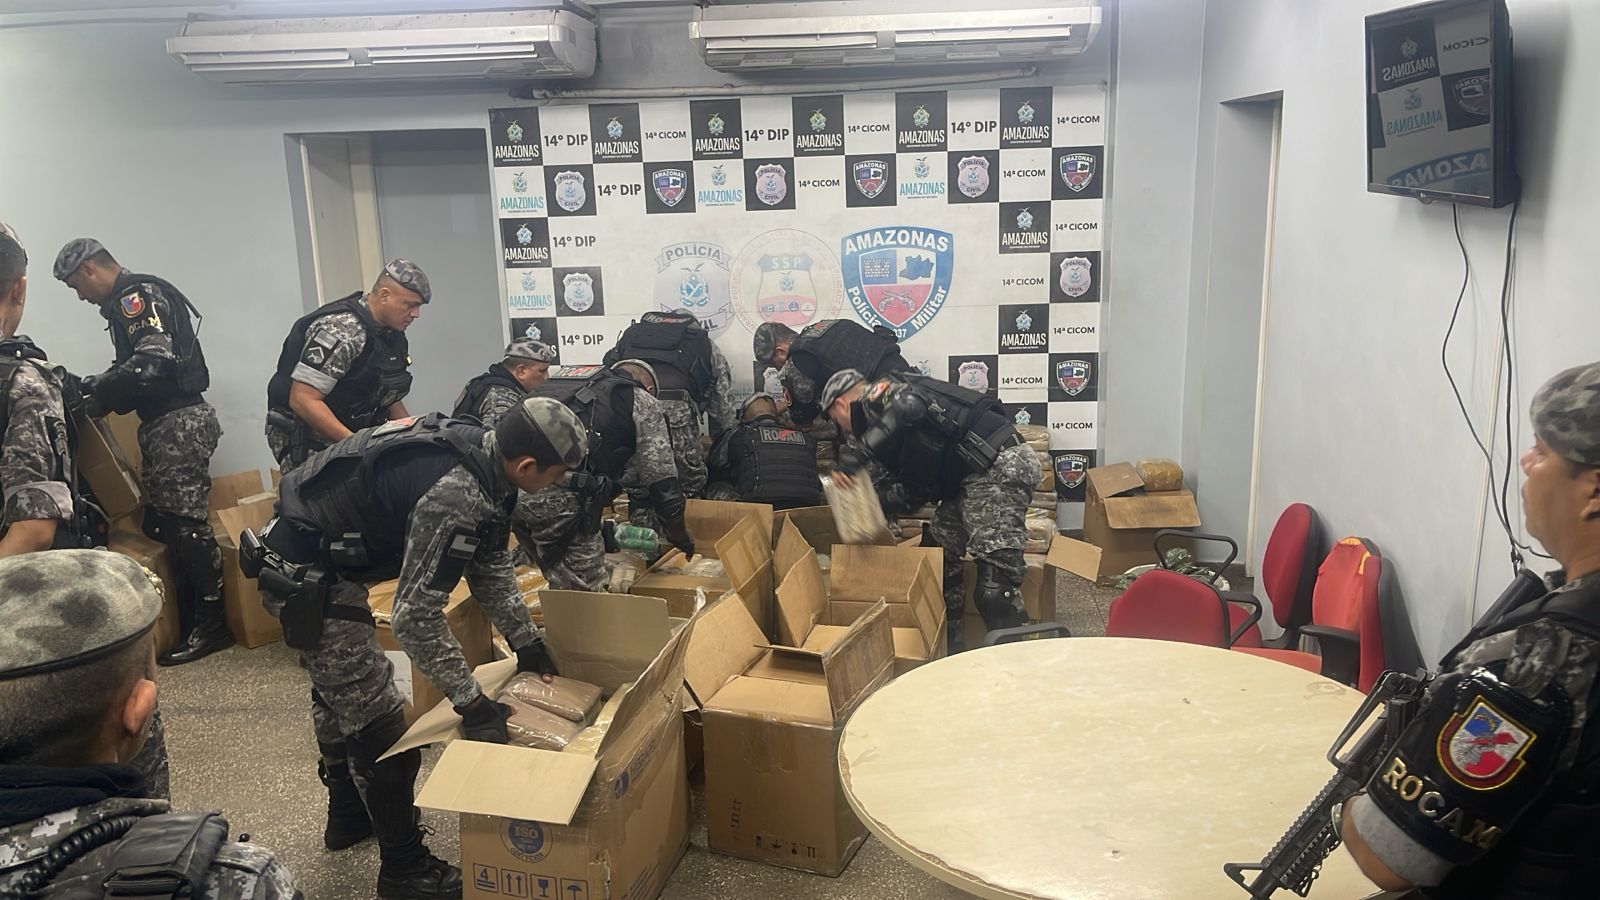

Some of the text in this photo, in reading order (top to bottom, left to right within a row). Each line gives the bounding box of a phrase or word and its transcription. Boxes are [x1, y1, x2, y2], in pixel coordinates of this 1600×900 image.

[1071, 115, 1100, 124] CICOM
[862, 124, 890, 133] CICOM
[974, 120, 997, 133] DIP
[1003, 126, 1049, 140] AMAZONAS
[567, 134, 588, 146] DIP
[659, 131, 686, 139] CICOM
[768, 129, 789, 141] DIP
[797, 133, 842, 148] AMAZONAS
[899, 130, 945, 144] AMAZONAS
[594, 141, 639, 155] AMAZONAS
[695, 137, 740, 151] AMAZONAS
[495, 144, 539, 158] AMAZONAS
[1062, 155, 1093, 163] AMAZONAS
[855, 162, 886, 170] AMAZONAS
[1017, 169, 1046, 177] CICOM
[812, 179, 840, 187] CICOM
[900, 182, 944, 196] AMAZONAS
[620, 184, 642, 196] DIP
[698, 189, 742, 203] AMAZONAS
[500, 196, 544, 209] AMAZONAS
[1069, 222, 1098, 231] CICOM
[575, 235, 596, 247] DIP
[845, 229, 949, 256] AMAZONAS
[1002, 231, 1048, 245] AMAZONAS
[505, 247, 548, 260] AMAZONAS
[665, 245, 721, 261] POLÍCIA
[1016, 277, 1044, 286] CICOM
[509, 295, 552, 308] AMAZONAS
[910, 286, 947, 330] Militar
[1066, 326, 1095, 334] CICOM
[583, 334, 604, 346] DIP
[1002, 333, 1046, 346] AMAZONAS
[1015, 376, 1043, 384] CICOM
[1065, 422, 1093, 430] CICOM
[1382, 756, 1504, 849] ROCAM
